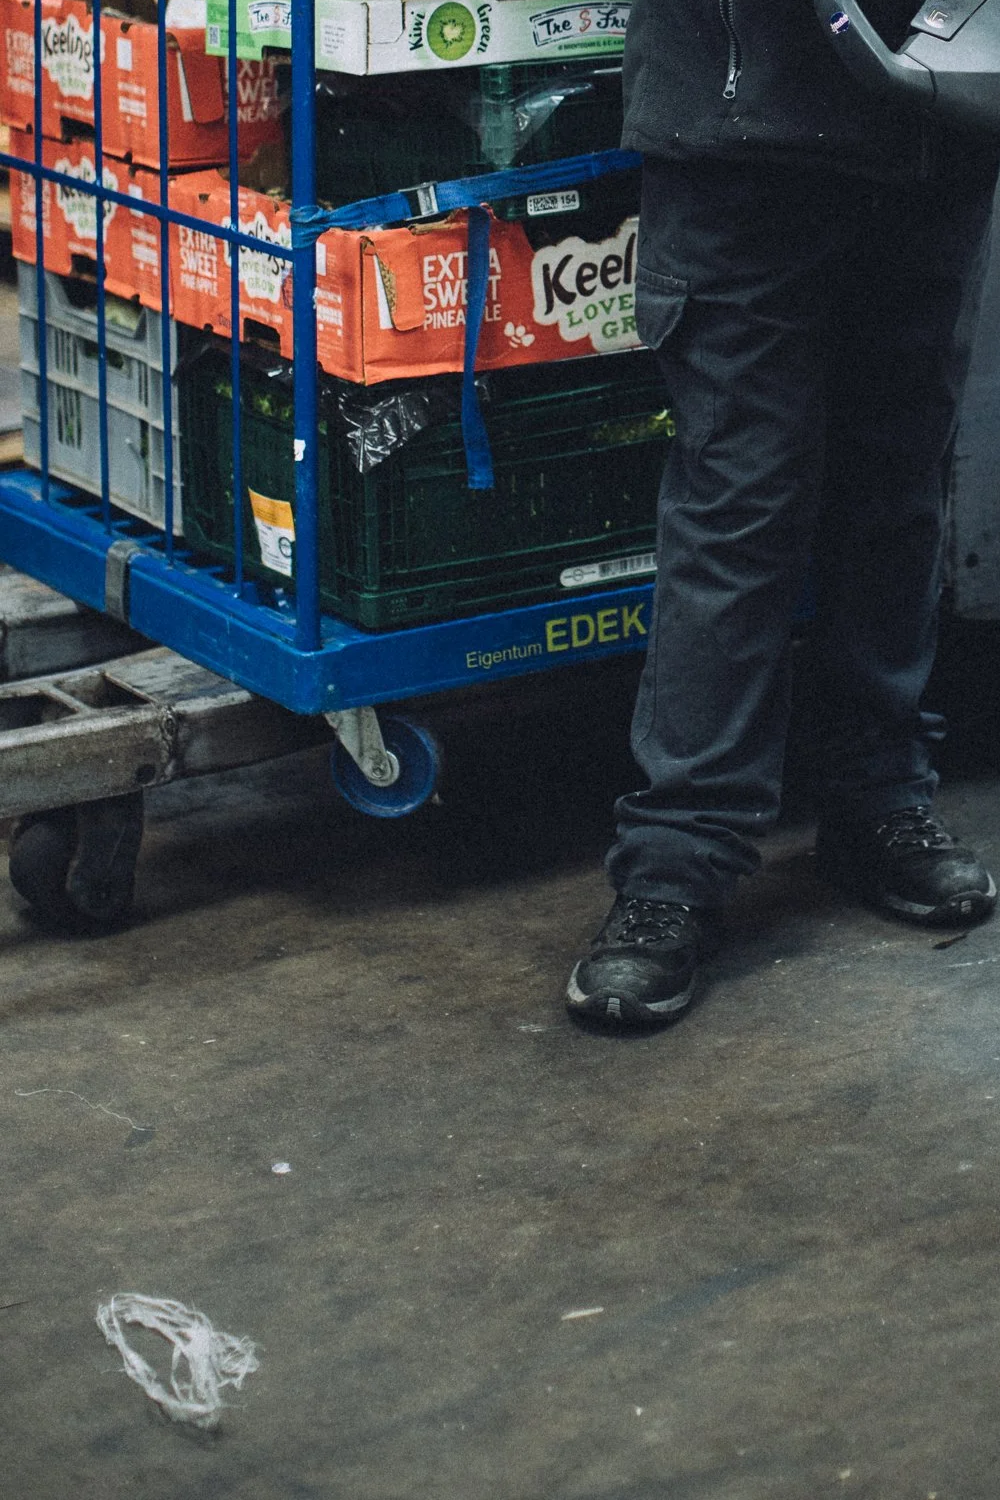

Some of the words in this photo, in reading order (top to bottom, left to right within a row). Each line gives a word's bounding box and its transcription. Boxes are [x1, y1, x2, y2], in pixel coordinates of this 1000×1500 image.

[409, 10, 426, 51] Kiwi
[477, 2, 493, 53] Green
[538, 16, 573, 37] Tre
[596, 8, 627, 29] Fru
[42, 20, 93, 73] Keeling
[560, 194, 577, 205] 154
[178, 225, 217, 255] EXTRA
[180, 247, 218, 279] SWEET
[423, 247, 501, 283] EXTA
[542, 232, 637, 316] Keel
[423, 275, 501, 311] SWET
[566, 293, 634, 329] LOVE
[423, 303, 502, 332] PINEALE
[602, 316, 637, 341] GR
[466, 643, 543, 670] Eigentum
[545, 603, 648, 653] EDEK
